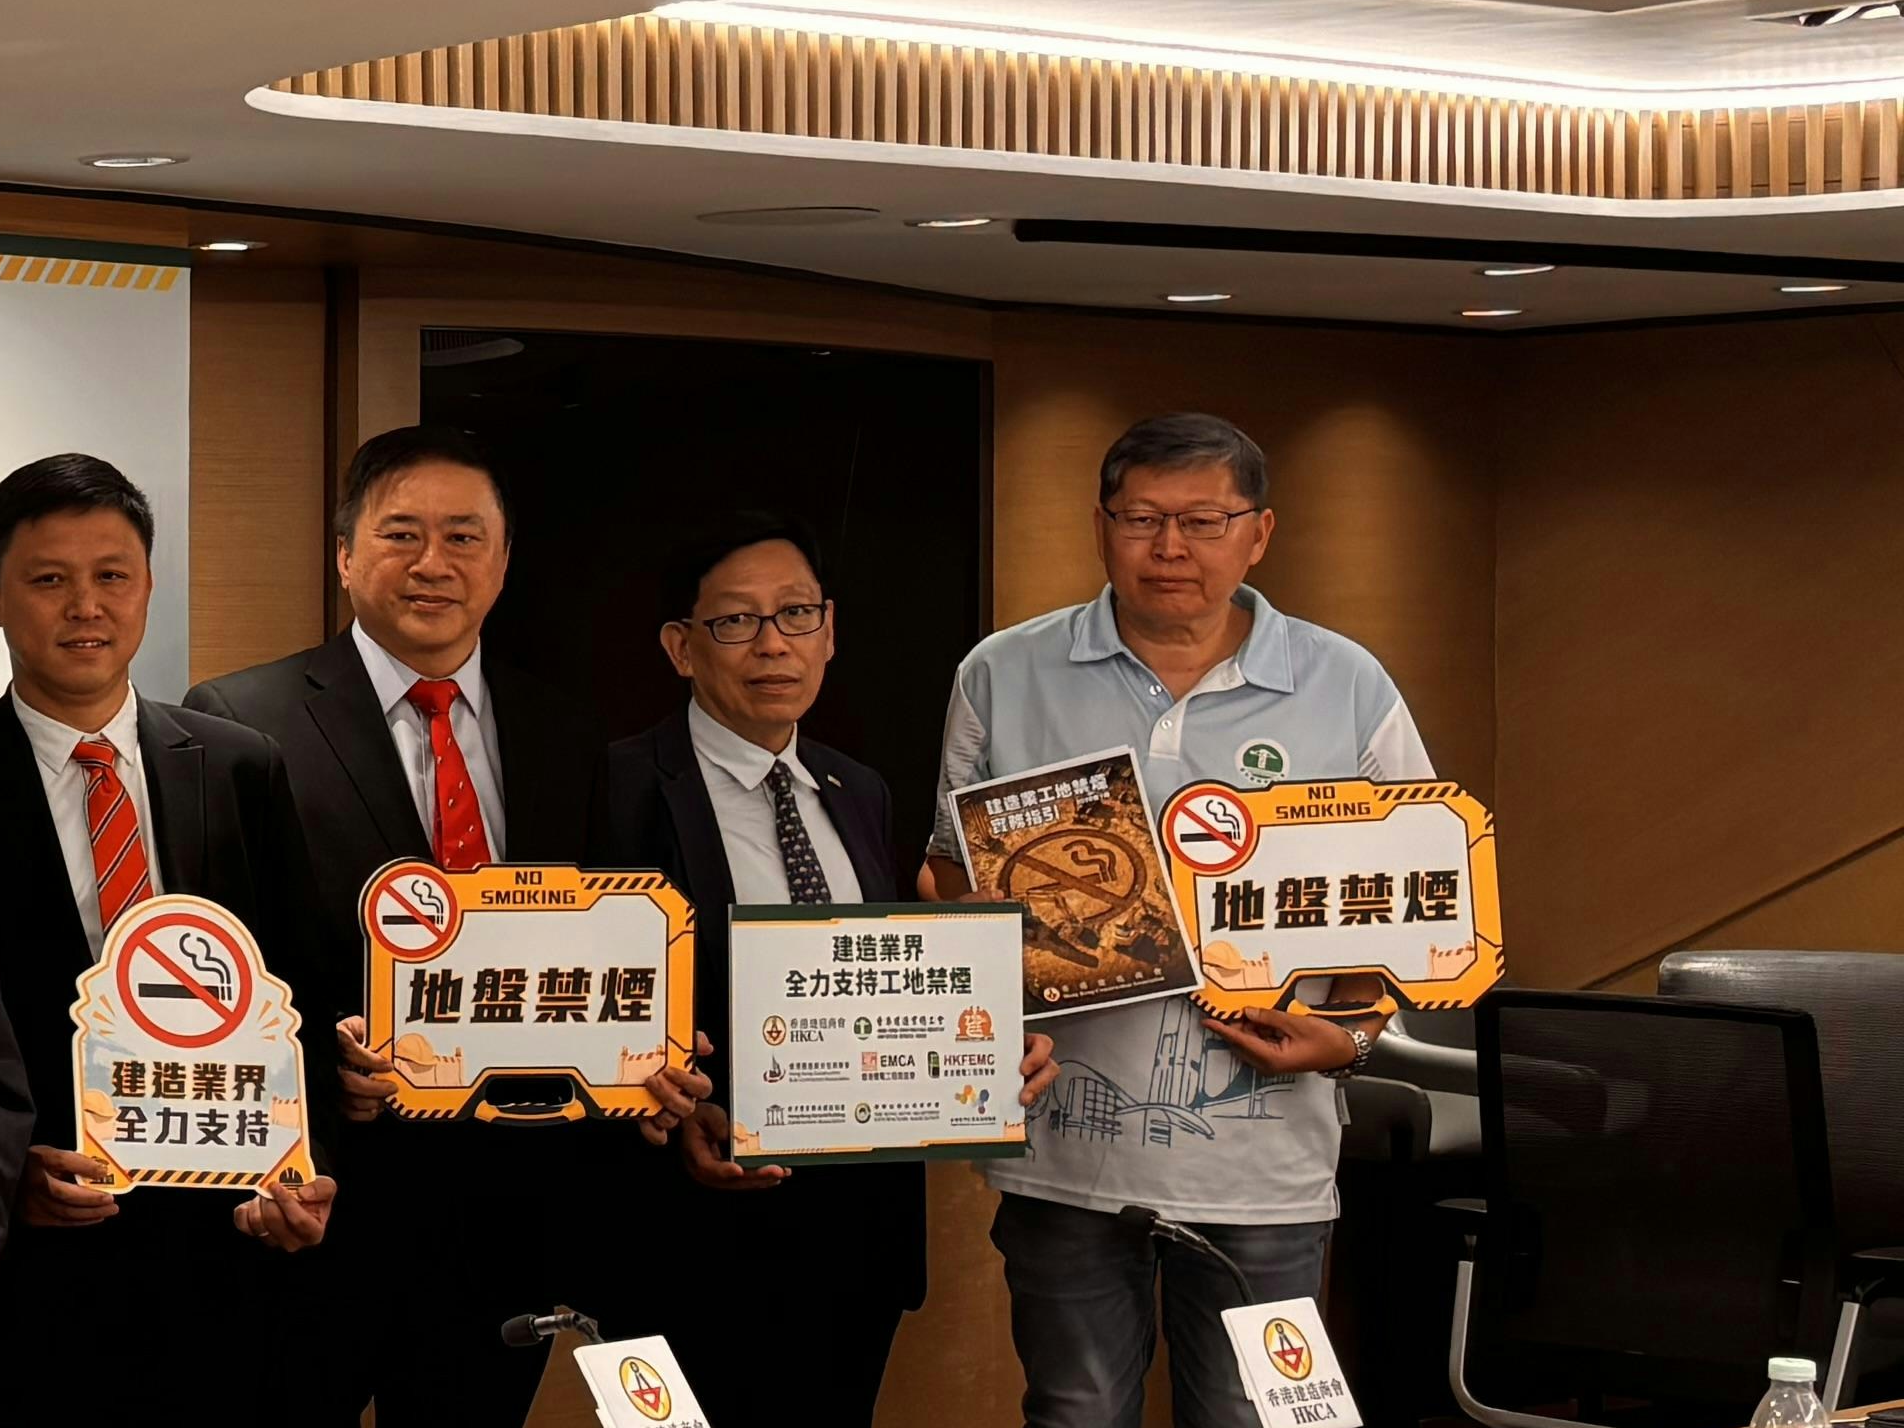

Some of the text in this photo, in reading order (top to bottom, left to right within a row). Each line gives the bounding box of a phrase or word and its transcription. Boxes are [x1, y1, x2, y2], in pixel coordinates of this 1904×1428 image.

[1308, 786, 1335, 800] NO
[1276, 802, 1371, 819] SMOKING
[515, 871, 542, 885] NO
[481, 890, 576, 905] SMOKING
[1209, 869, 1460, 932] 地盤禁煙
[832, 934, 924, 962] 建造業界
[785, 967, 972, 998] 全力支持工地禁煙
[405, 967, 657, 1024] 地盤禁煙
[880, 1055, 916, 1067] EMCA
[944, 1054, 995, 1066] HKFEMC
[112, 1060, 266, 1101] 建造業界
[114, 1106, 270, 1147] 全力支持
[1292, 1403, 1337, 1425] HKCA
